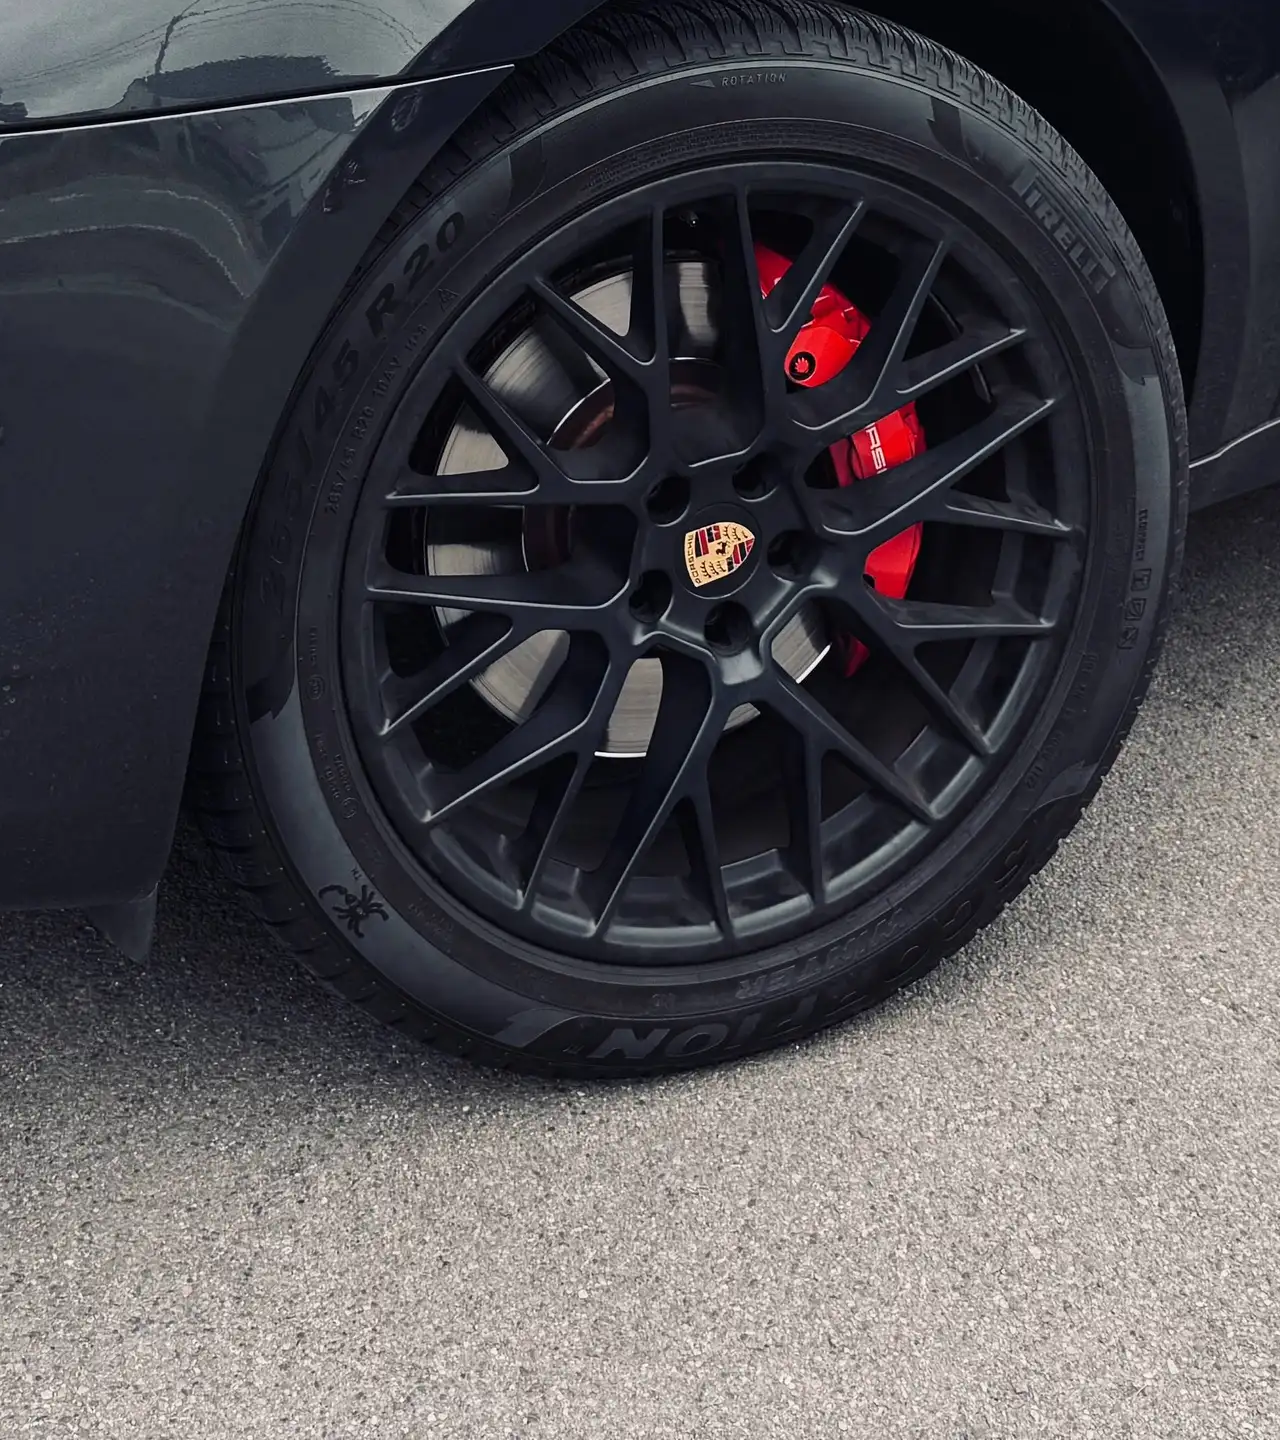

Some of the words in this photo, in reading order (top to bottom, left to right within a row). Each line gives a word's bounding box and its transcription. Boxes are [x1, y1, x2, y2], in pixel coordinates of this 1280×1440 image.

[720, 72, 787, 87] ROTATION
[1010, 160, 1117, 295] PIRELLI
[365, 212, 466, 340] R20
[686, 533, 702, 584] PORSCHE
